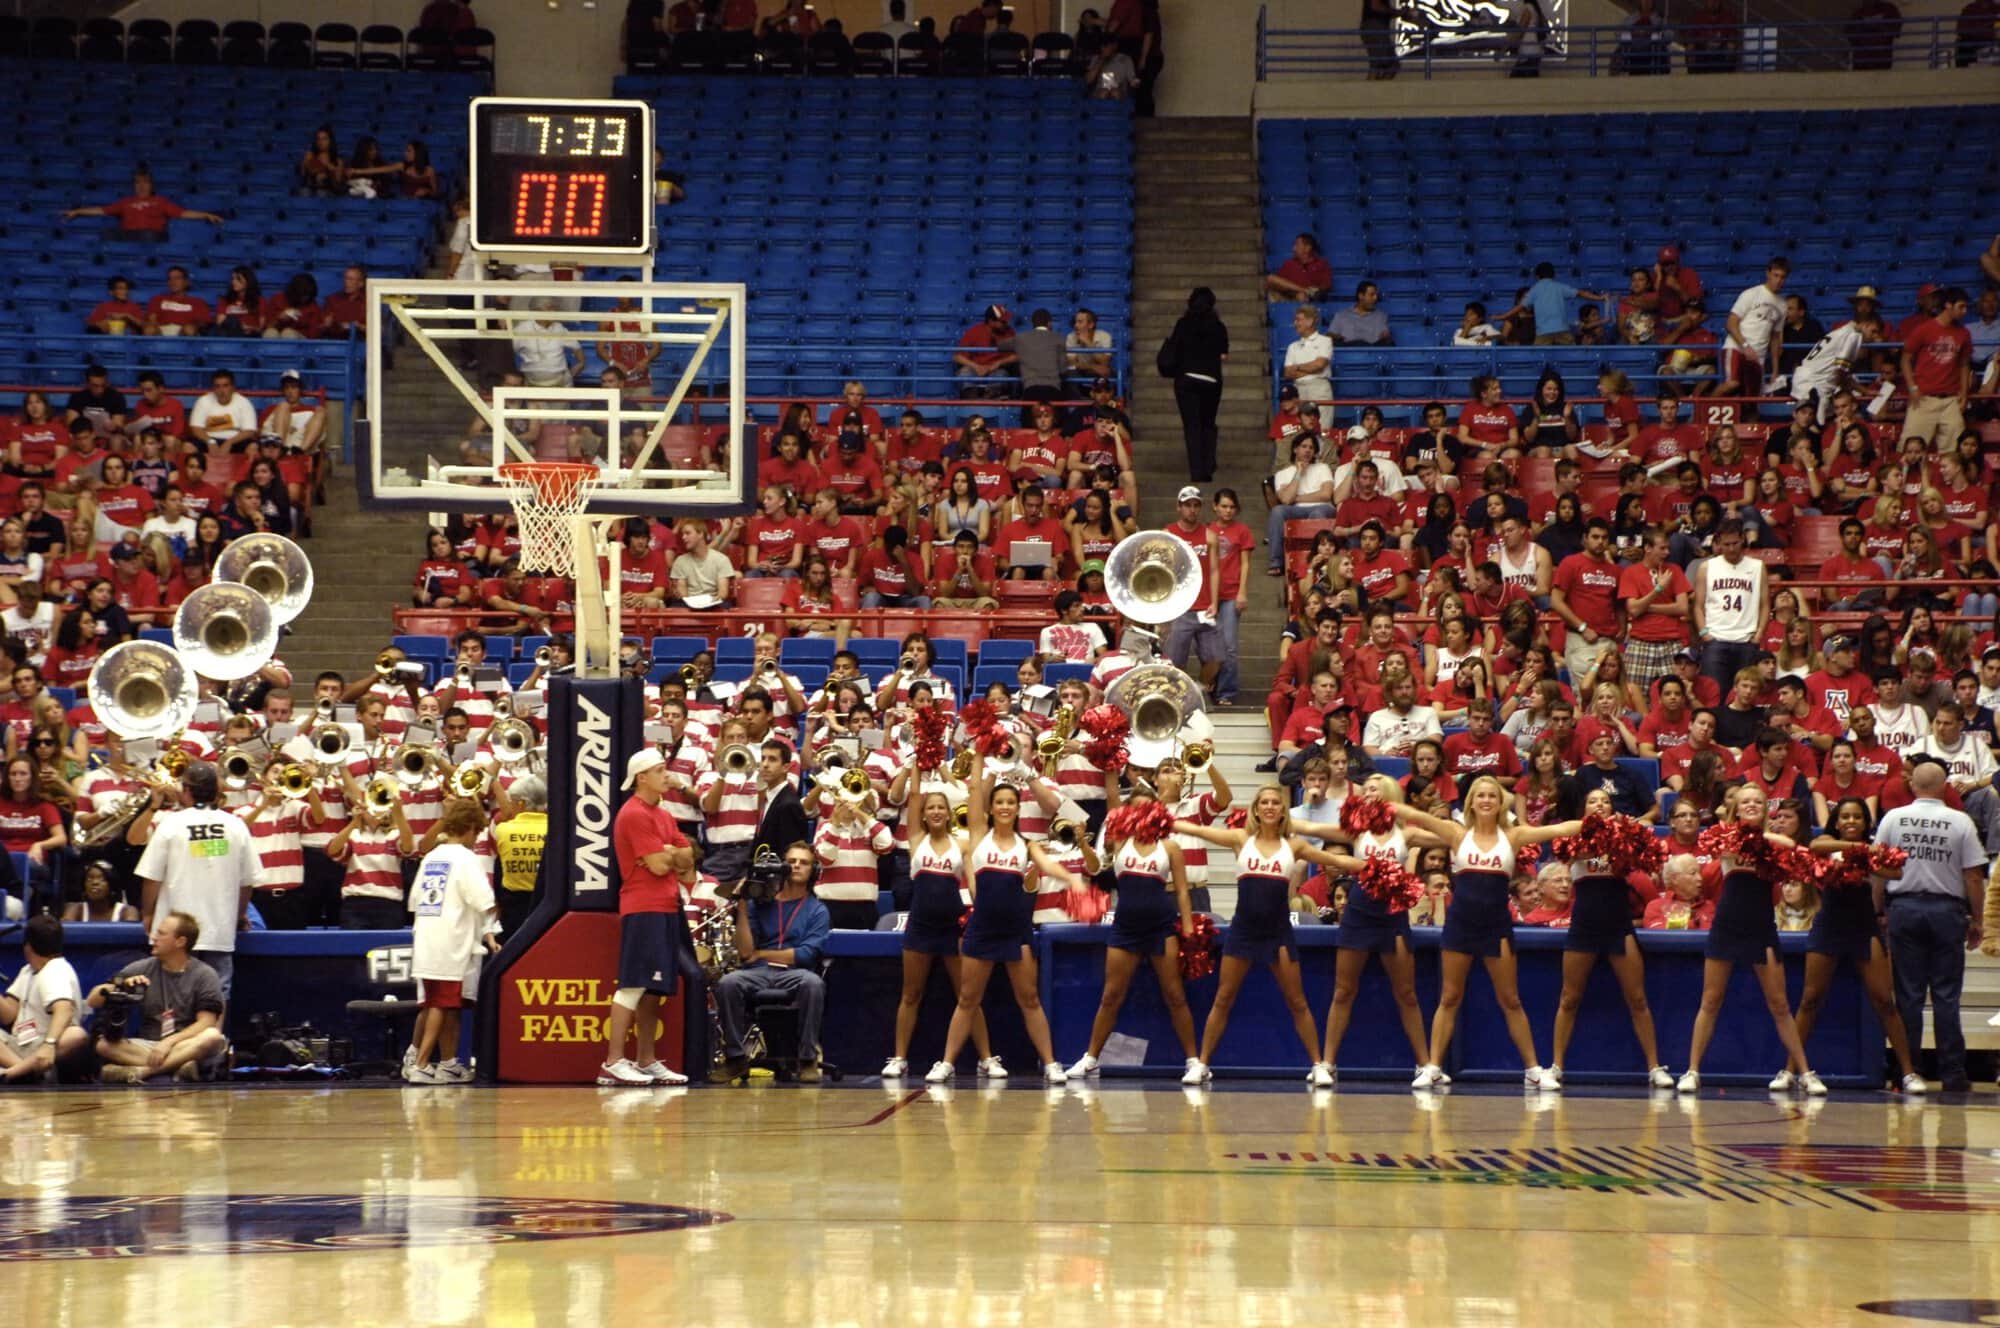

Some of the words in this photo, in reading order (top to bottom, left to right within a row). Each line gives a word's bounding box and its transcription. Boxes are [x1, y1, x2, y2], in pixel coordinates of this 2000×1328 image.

[527, 116, 626, 156] 7:33
[515, 173, 606, 236] 00
[1708, 406, 1734, 424] 22
[1712, 578, 1753, 593] ARIZONA
[1722, 595, 1743, 612] 34
[743, 623, 766, 638] 21
[575, 693, 612, 891] ARIZONA
[187, 824, 225, 841] HS
[1899, 817, 1953, 831] EVENT
[1902, 832, 1949, 846] STAFF
[516, 978, 667, 1006] WEL
